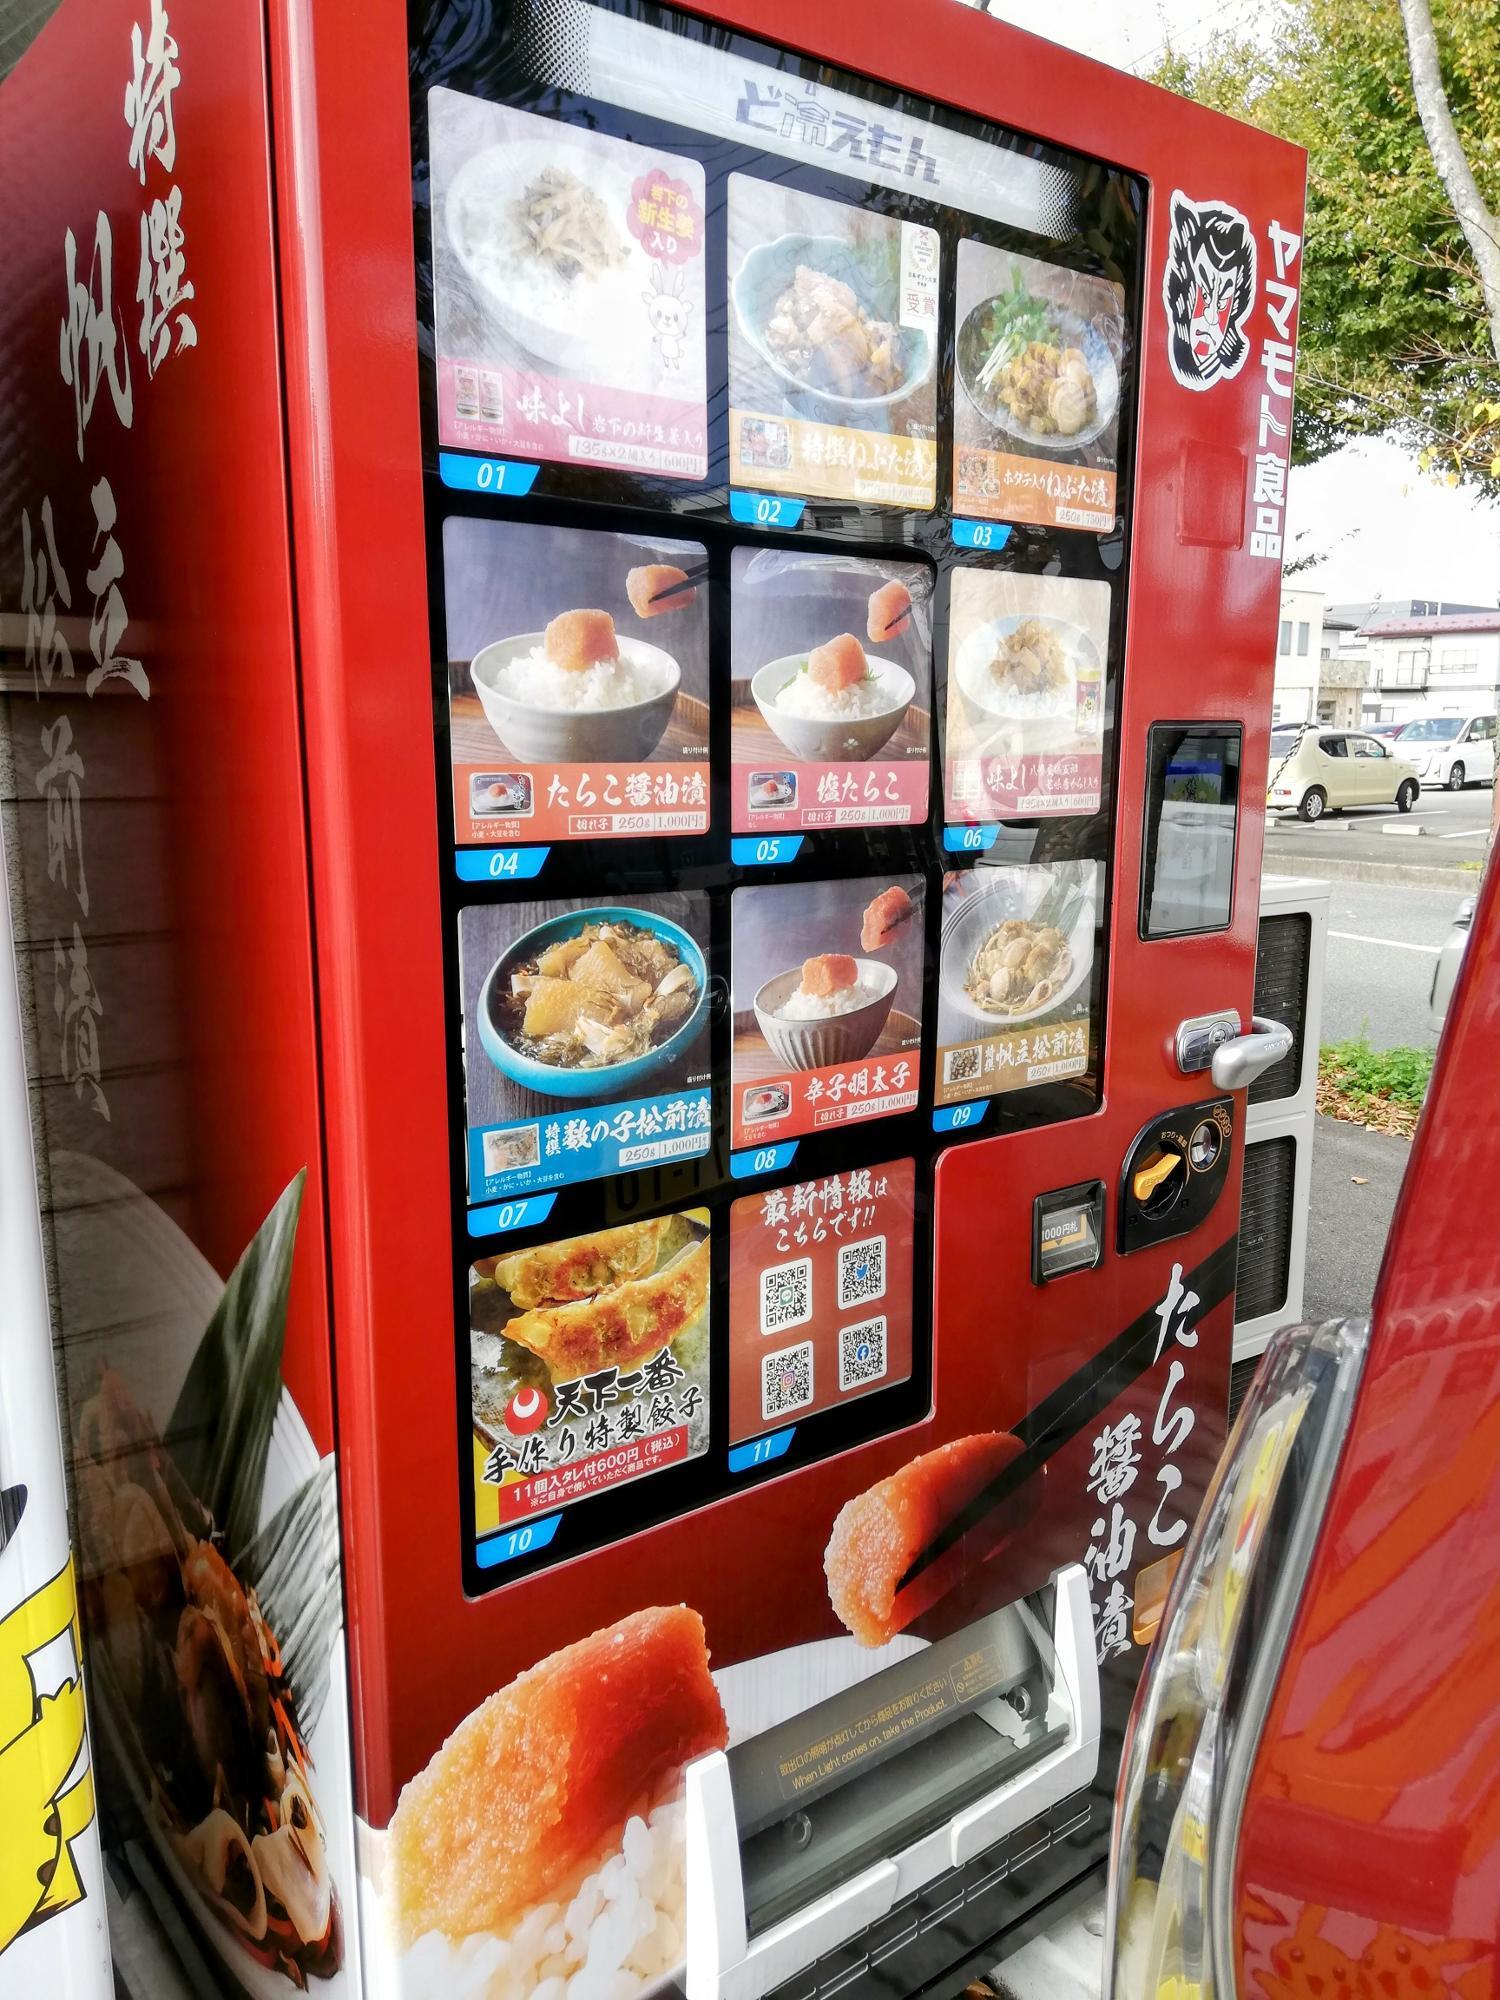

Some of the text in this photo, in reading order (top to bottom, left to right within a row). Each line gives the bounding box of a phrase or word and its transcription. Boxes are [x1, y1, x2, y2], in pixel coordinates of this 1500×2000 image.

[736, 80, 940, 185] ど冷えもん
[650, 231, 677, 254] 入り
[907, 294, 935, 317] 受賞
[1249, 219, 1301, 559] ヤマモト食品
[516, 384, 587, 432] 味よし
[476, 463, 505, 489] 01
[758, 499, 781, 522] 02
[973, 526, 992, 545] 03
[817, 771, 899, 804] 塩たらこ
[986, 763, 1026, 792] 味よし
[618, 817, 650, 829] 250g
[756, 840, 780, 861] 05
[963, 829, 982, 847] 06
[489, 853, 518, 876] 04
[804, 1061, 911, 1107] 辛子明太子
[952, 1107, 971, 1126] 09
[754, 1149, 777, 1172] 08
[760, 1169, 887, 1227] 最新情報は
[498, 1202, 528, 1228] 07
[1042, 1220, 1078, 1240] 1000円札
[549, 1348, 684, 1426] 天下一番
[1147, 1262, 1200, 1547] たらこ
[482, 1386, 704, 1484] 手作り特製餃子
[754, 1439, 772, 1462] 11
[508, 1529, 532, 1555] 10
[792, 1771, 818, 1790] When
[818, 1756, 840, 1776] Light
[841, 1743, 868, 1763] comes
[882, 1725, 900, 1740] take
[901, 1717, 914, 1730] the
